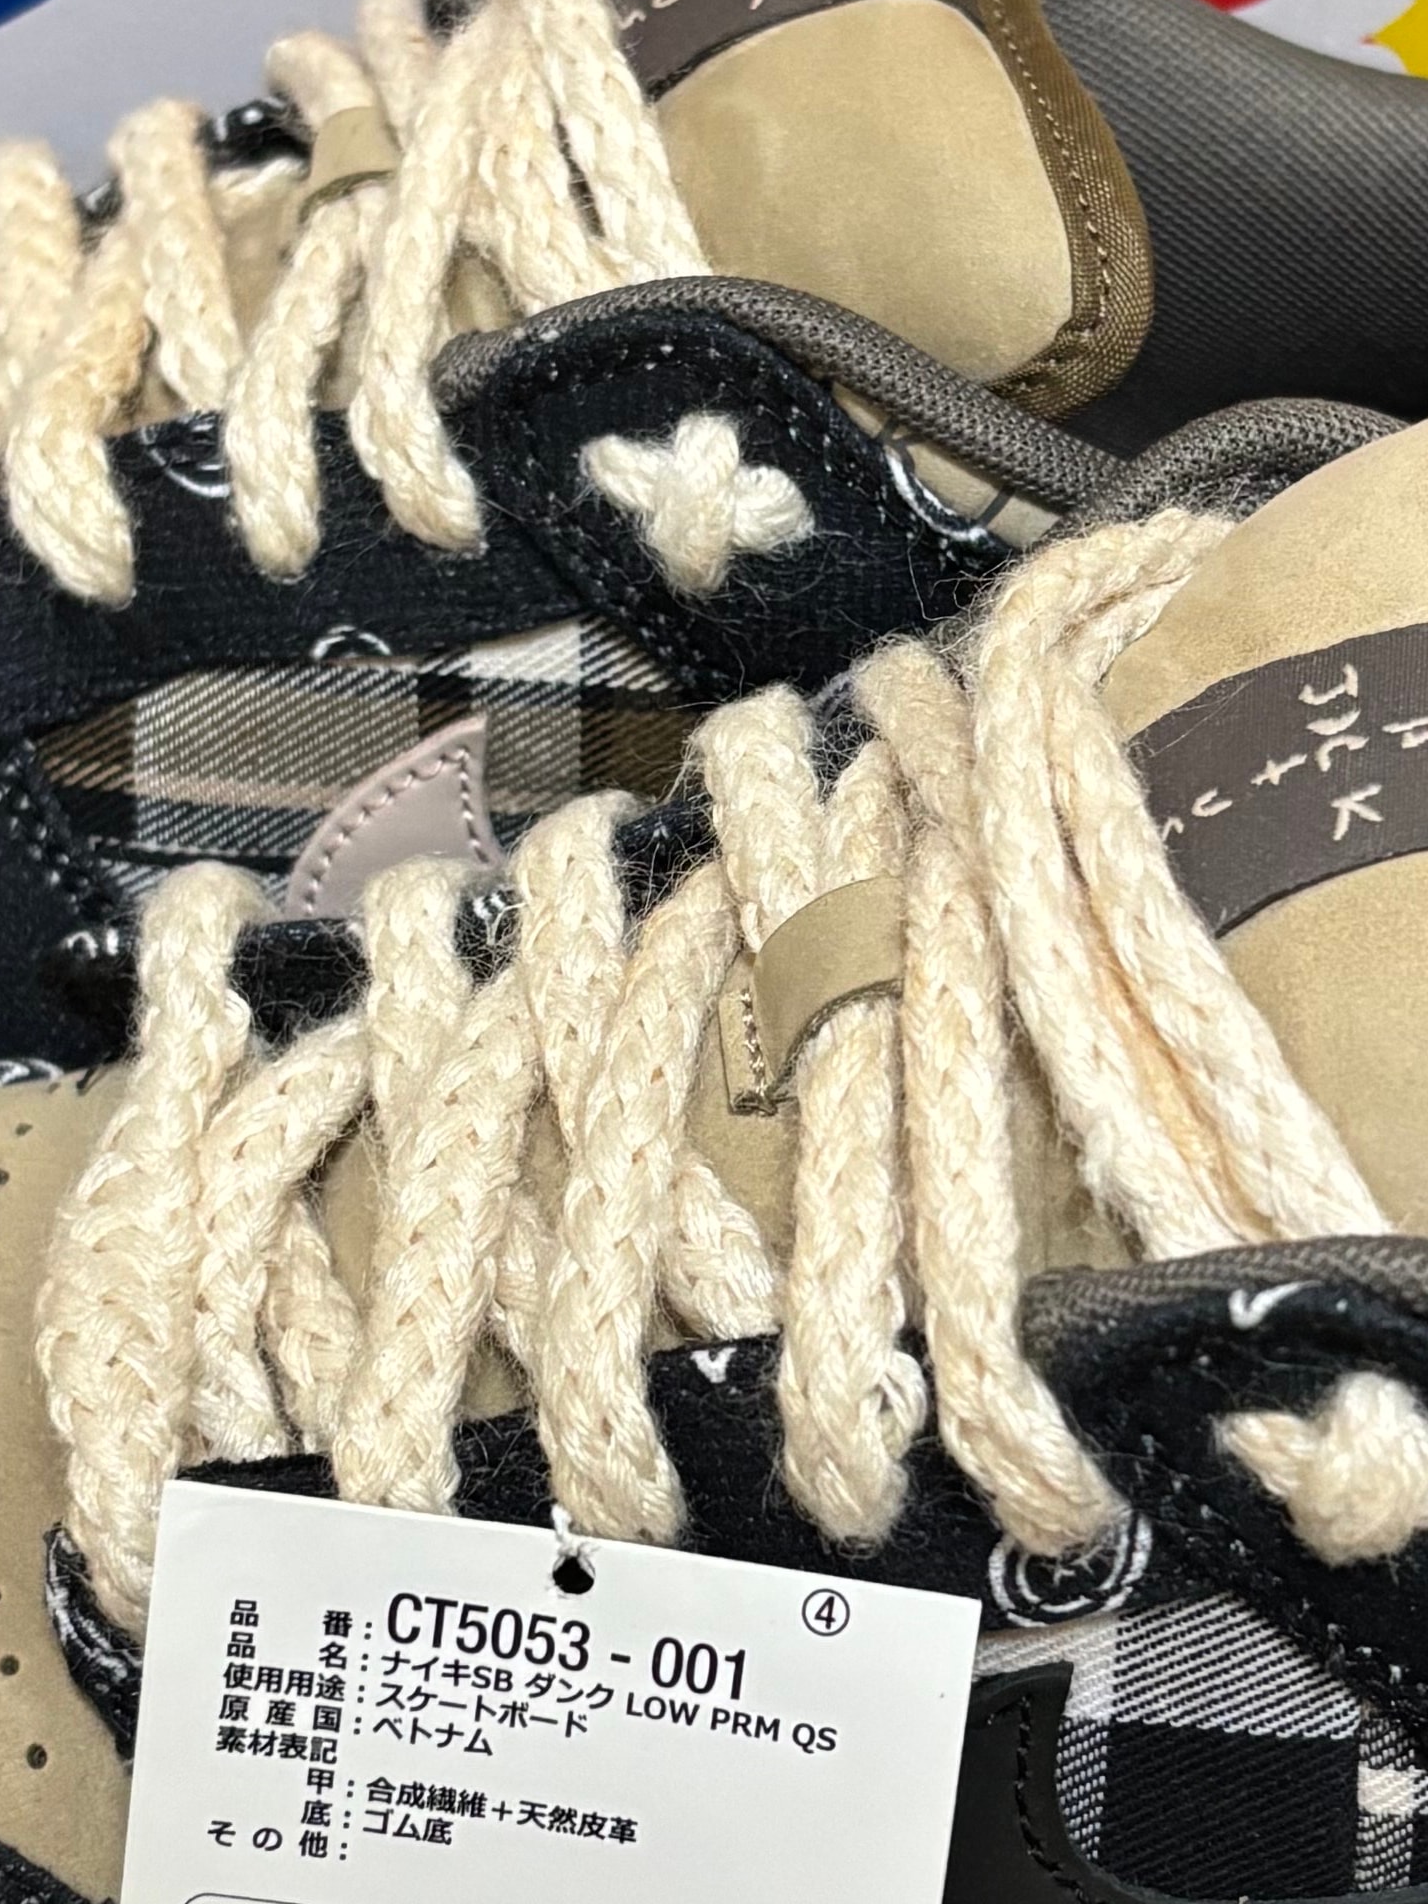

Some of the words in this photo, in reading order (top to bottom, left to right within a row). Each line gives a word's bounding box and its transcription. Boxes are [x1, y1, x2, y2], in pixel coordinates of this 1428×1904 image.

[387, 1592, 591, 1673] CT5053
[651, 1636, 747, 1701] 001
[215, 1724, 338, 1765] 素材表記
[625, 1692, 700, 1727] LOW
[710, 1708, 781, 1742] PRM
[792, 1722, 839, 1755] QS
